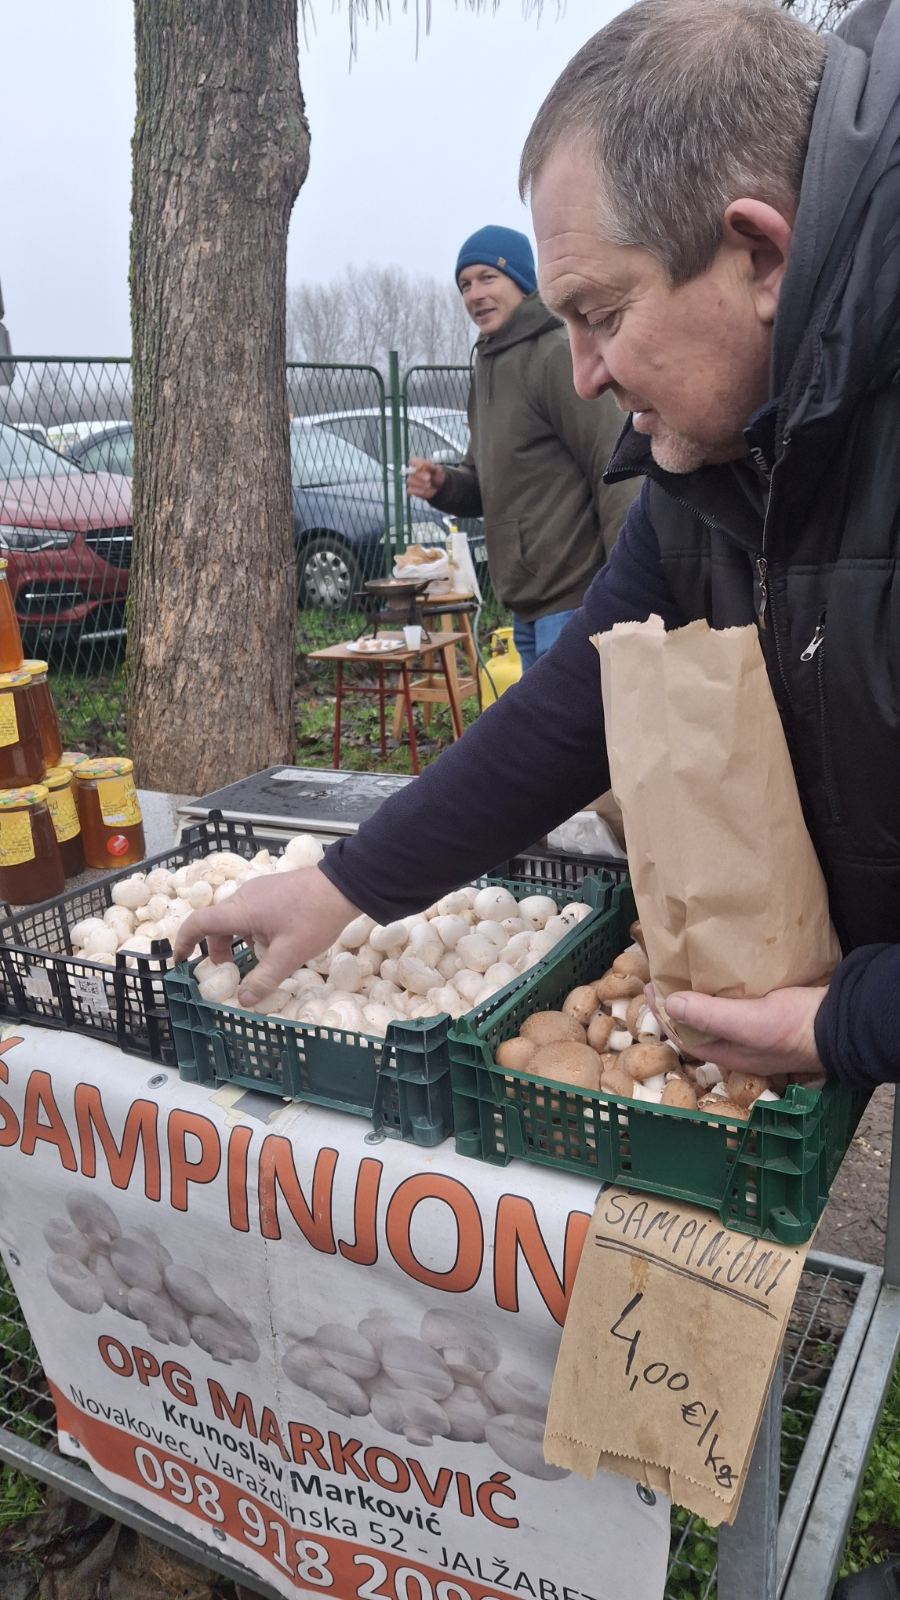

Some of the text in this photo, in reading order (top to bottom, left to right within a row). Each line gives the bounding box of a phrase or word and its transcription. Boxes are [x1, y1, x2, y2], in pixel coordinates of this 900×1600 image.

[610, 1292, 690, 1391] 4,00
[69, 1384, 199, 1465] Novakovec,
[203, 1446, 359, 1538] Varaždinska
[369, 1521, 408, 1553] 52
[97, 1335, 520, 1529] OPG MARKOVIĆ
[162, 1400, 442, 1537] Krunoslav Marković
[134, 1446, 504, 1600] 098 918 20
